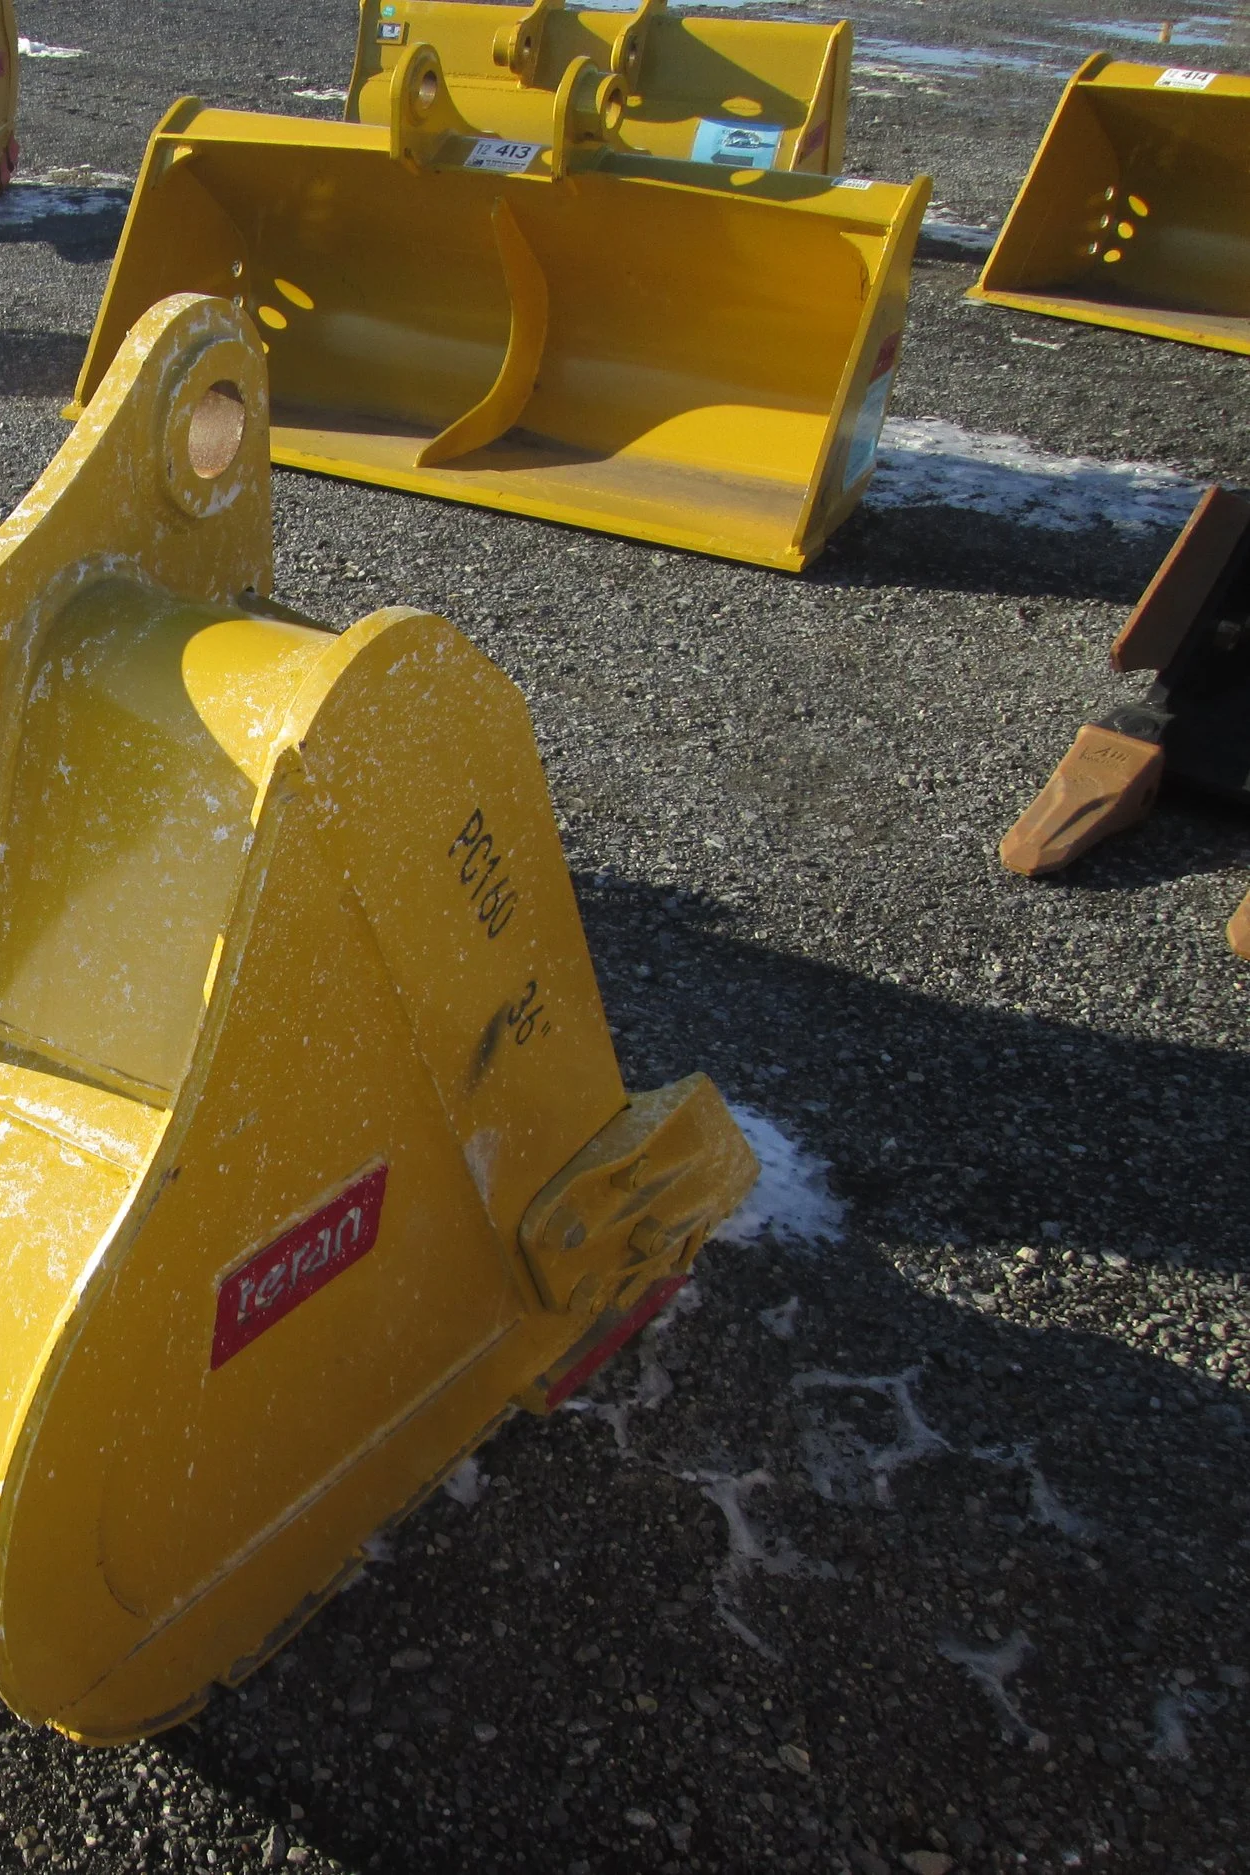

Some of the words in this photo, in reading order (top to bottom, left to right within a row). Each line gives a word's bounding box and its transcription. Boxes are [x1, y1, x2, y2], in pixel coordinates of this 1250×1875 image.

[476, 144, 492, 155] 12
[495, 144, 532, 159] 413
[448, 808, 518, 939] PC160
[236, 1206, 362, 1325] teran
